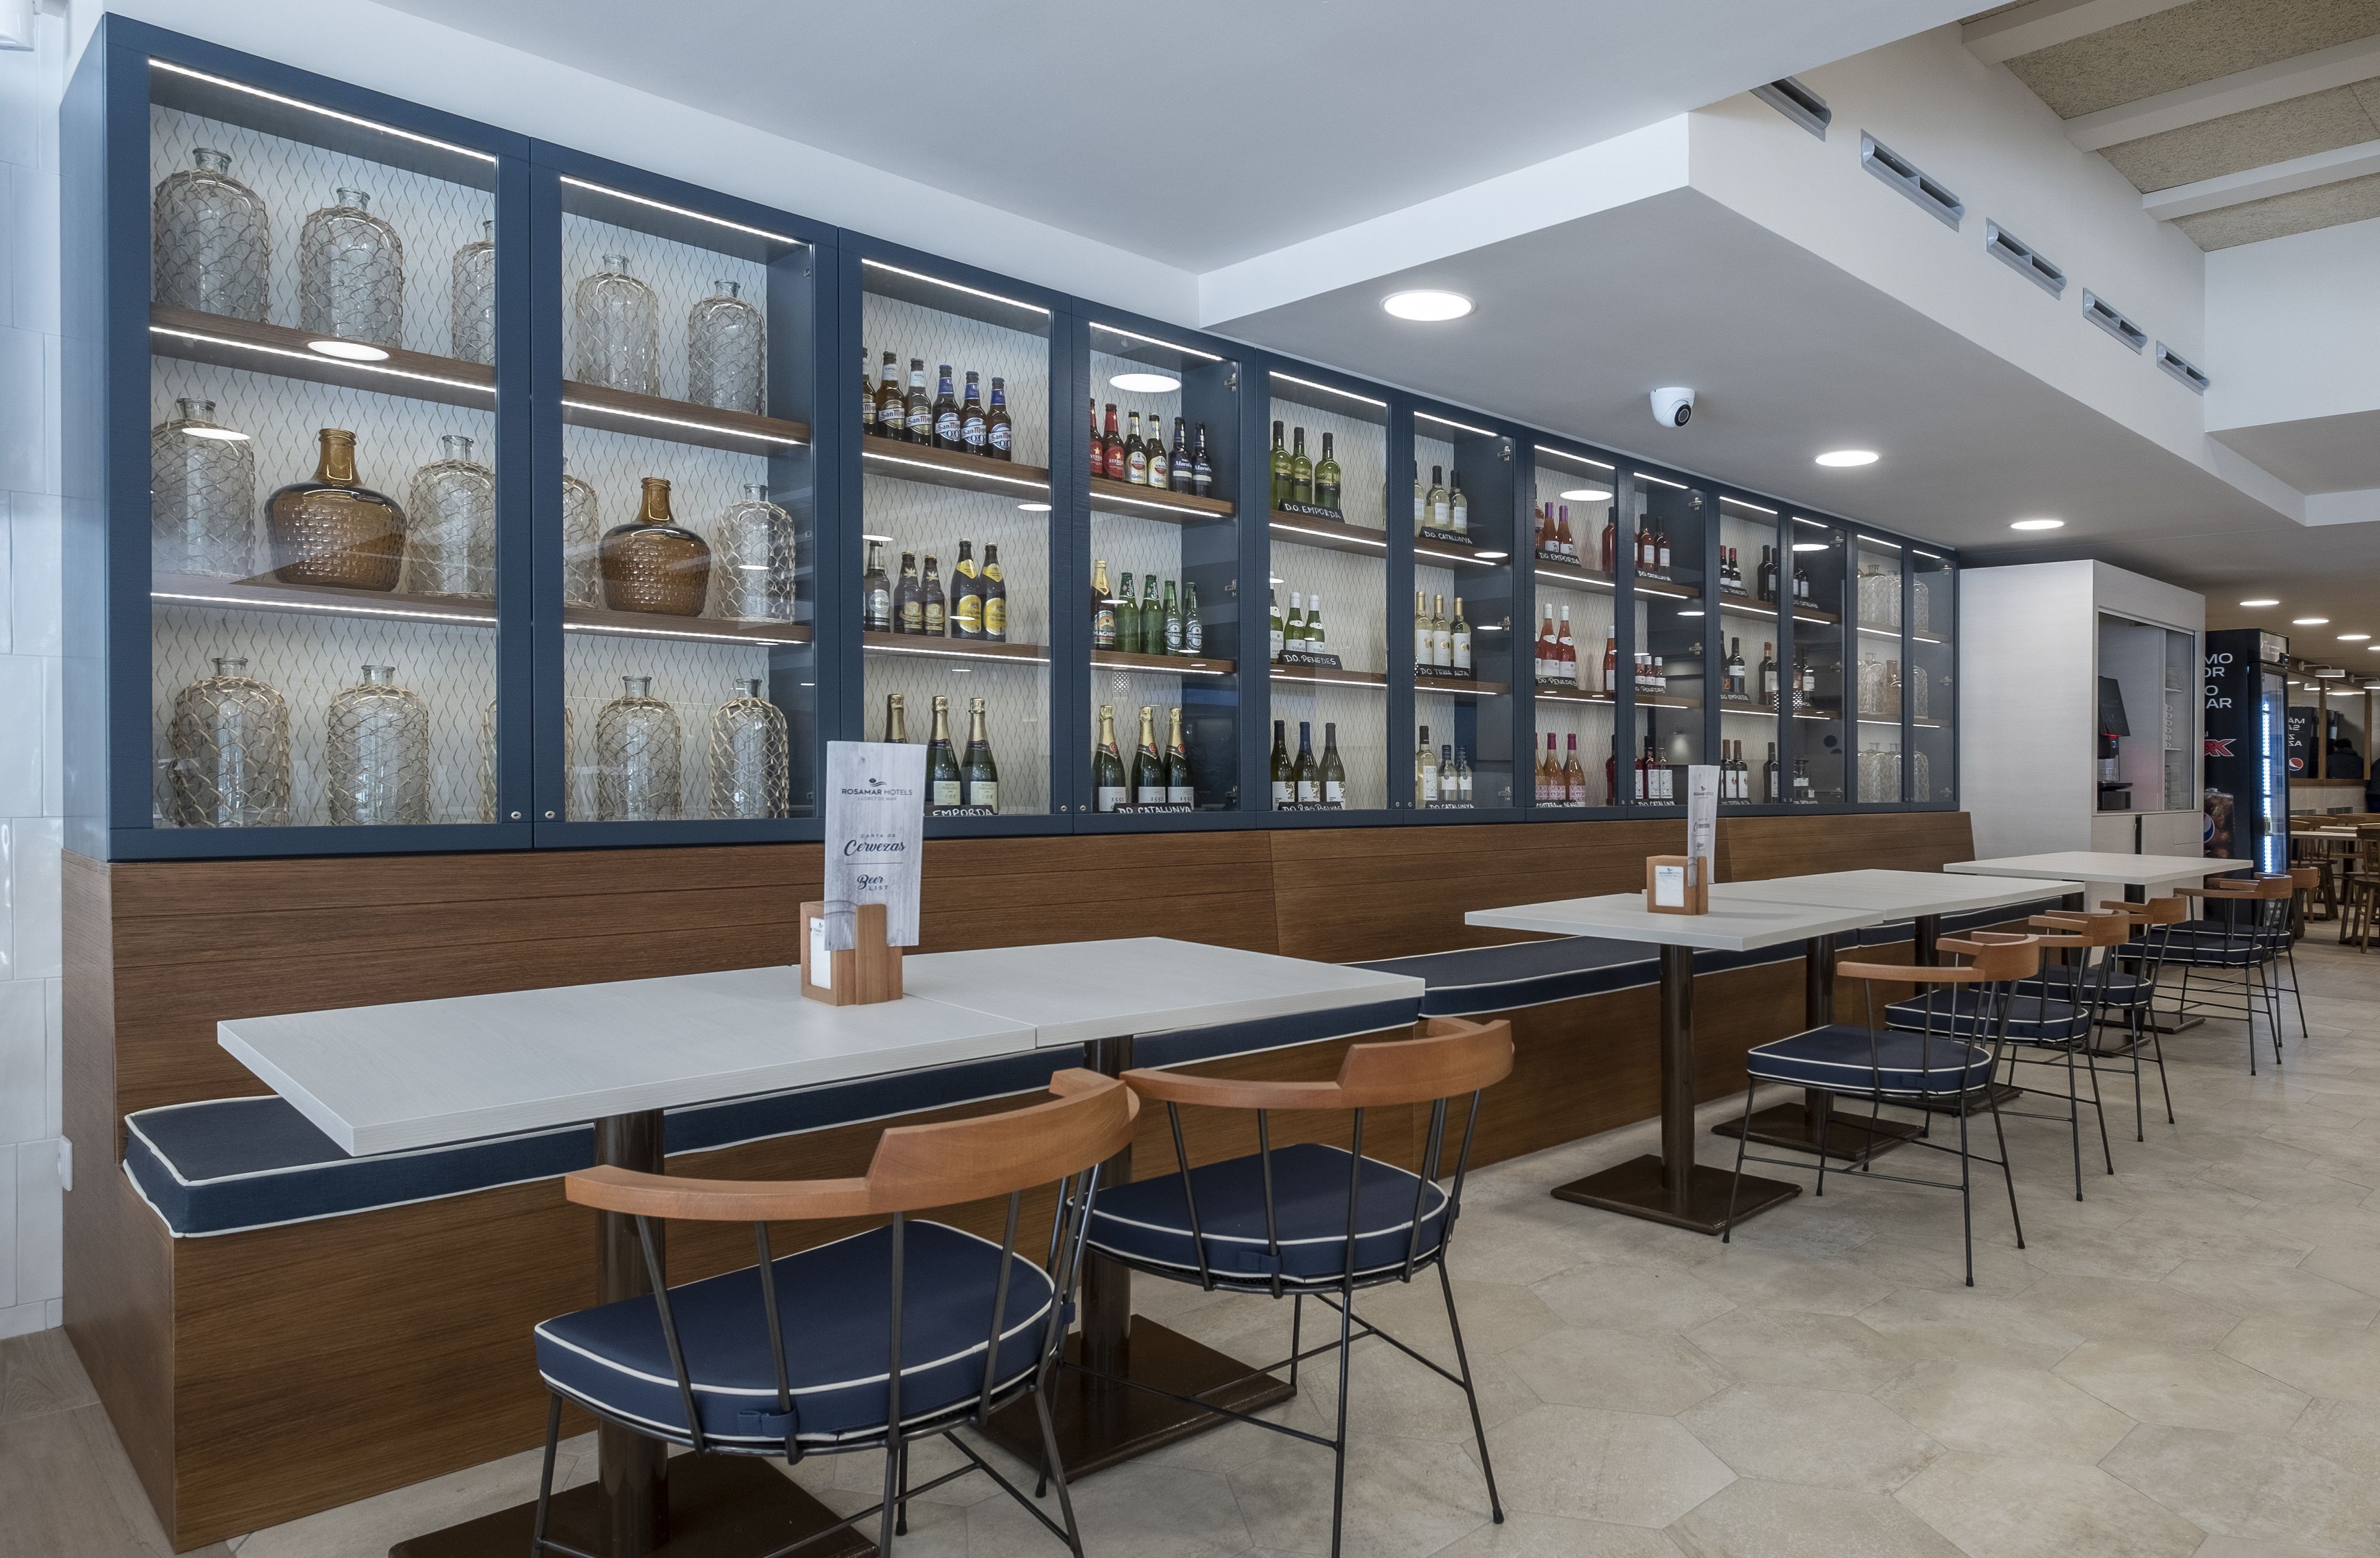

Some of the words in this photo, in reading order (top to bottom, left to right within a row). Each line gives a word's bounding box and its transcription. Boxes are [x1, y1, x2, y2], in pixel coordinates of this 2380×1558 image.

[880, 411, 893, 420] San
[907, 417, 920, 426] San
[937, 423, 950, 432] San
[963, 428, 974, 437] San
[989, 434, 1003, 443] San
[1302, 505, 1342, 519] EMPORDA
[1438, 533, 1473, 545] CATALUNYA
[1550, 554, 1582, 565] EMPORDA
[1301, 655, 1336, 665] PENEDES
[1548, 677, 1577, 686] PENEDES
[932, 808, 993, 817] EMPORDA
[1138, 806, 1191, 814] CATALUNYA
[844, 839, 907, 856] Cervezas
[857, 874, 884, 890] Beer
